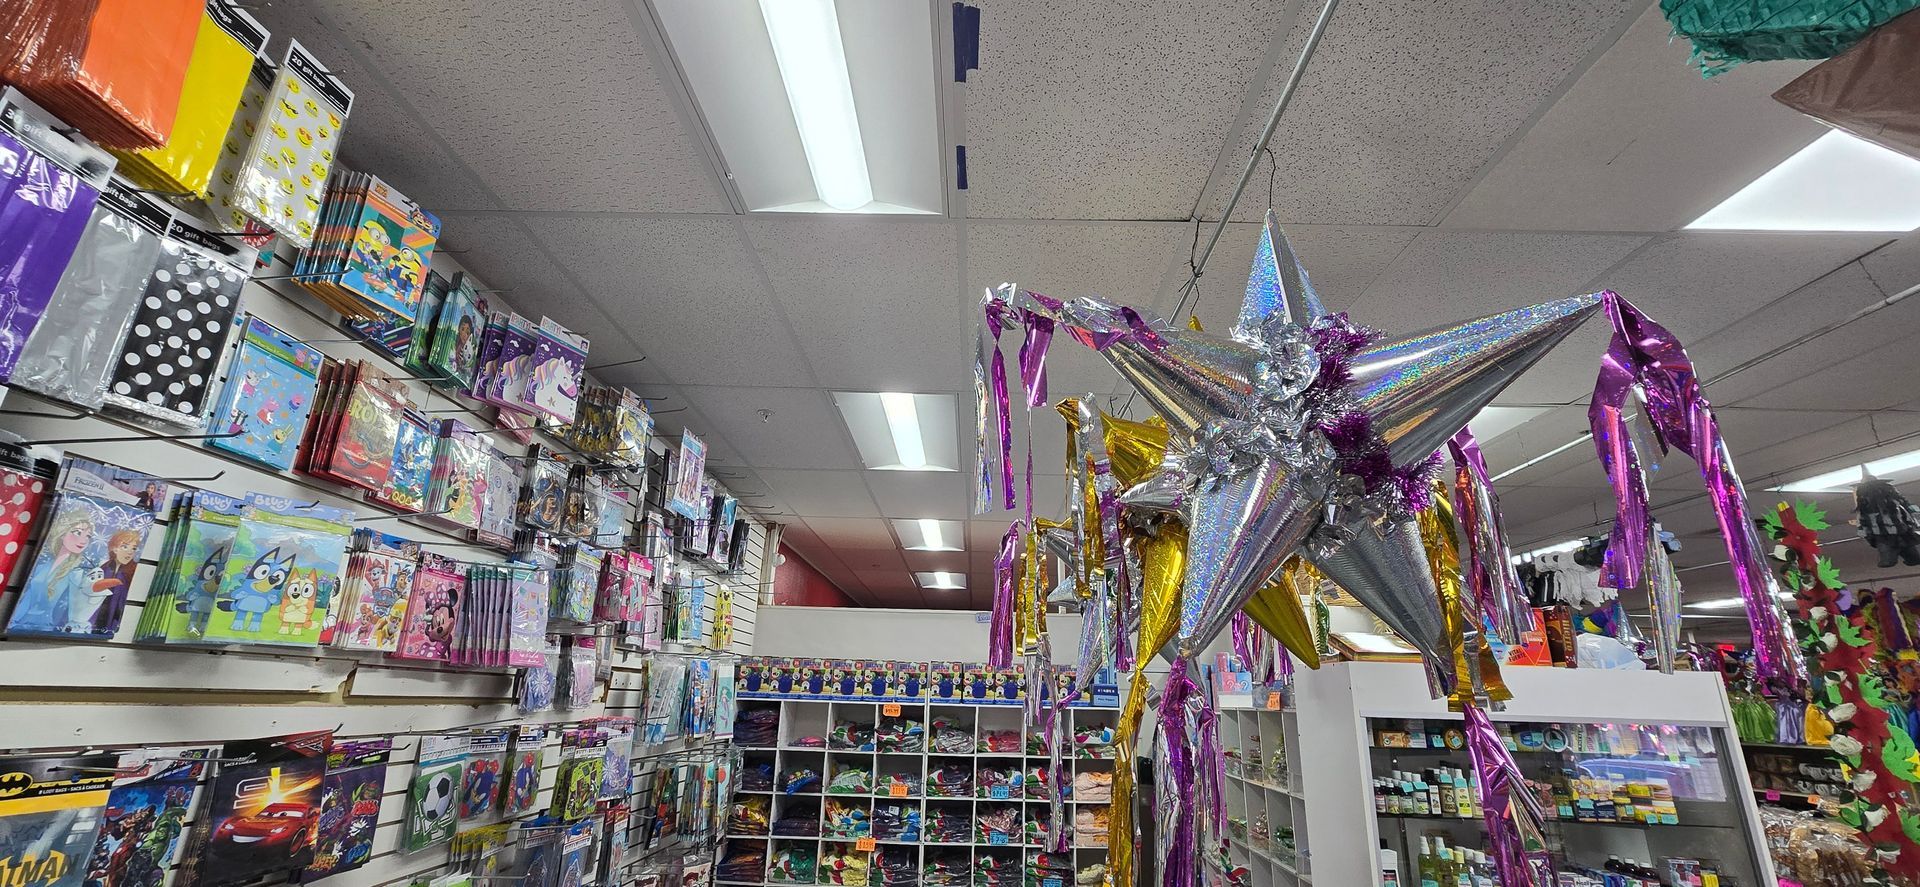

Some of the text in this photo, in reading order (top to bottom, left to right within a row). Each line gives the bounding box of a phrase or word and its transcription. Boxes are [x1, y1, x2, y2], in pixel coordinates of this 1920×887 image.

[218, 8, 232, 24] bags
[292, 55, 326, 88] 20 gift bags
[104, 185, 138, 209] gift bags
[170, 222, 221, 251] 20 gift bags
[0, 447, 30, 462] ift bags
[1508, 648, 1521, 656] VITAL
[1508, 652, 1527, 662] FUERTE
